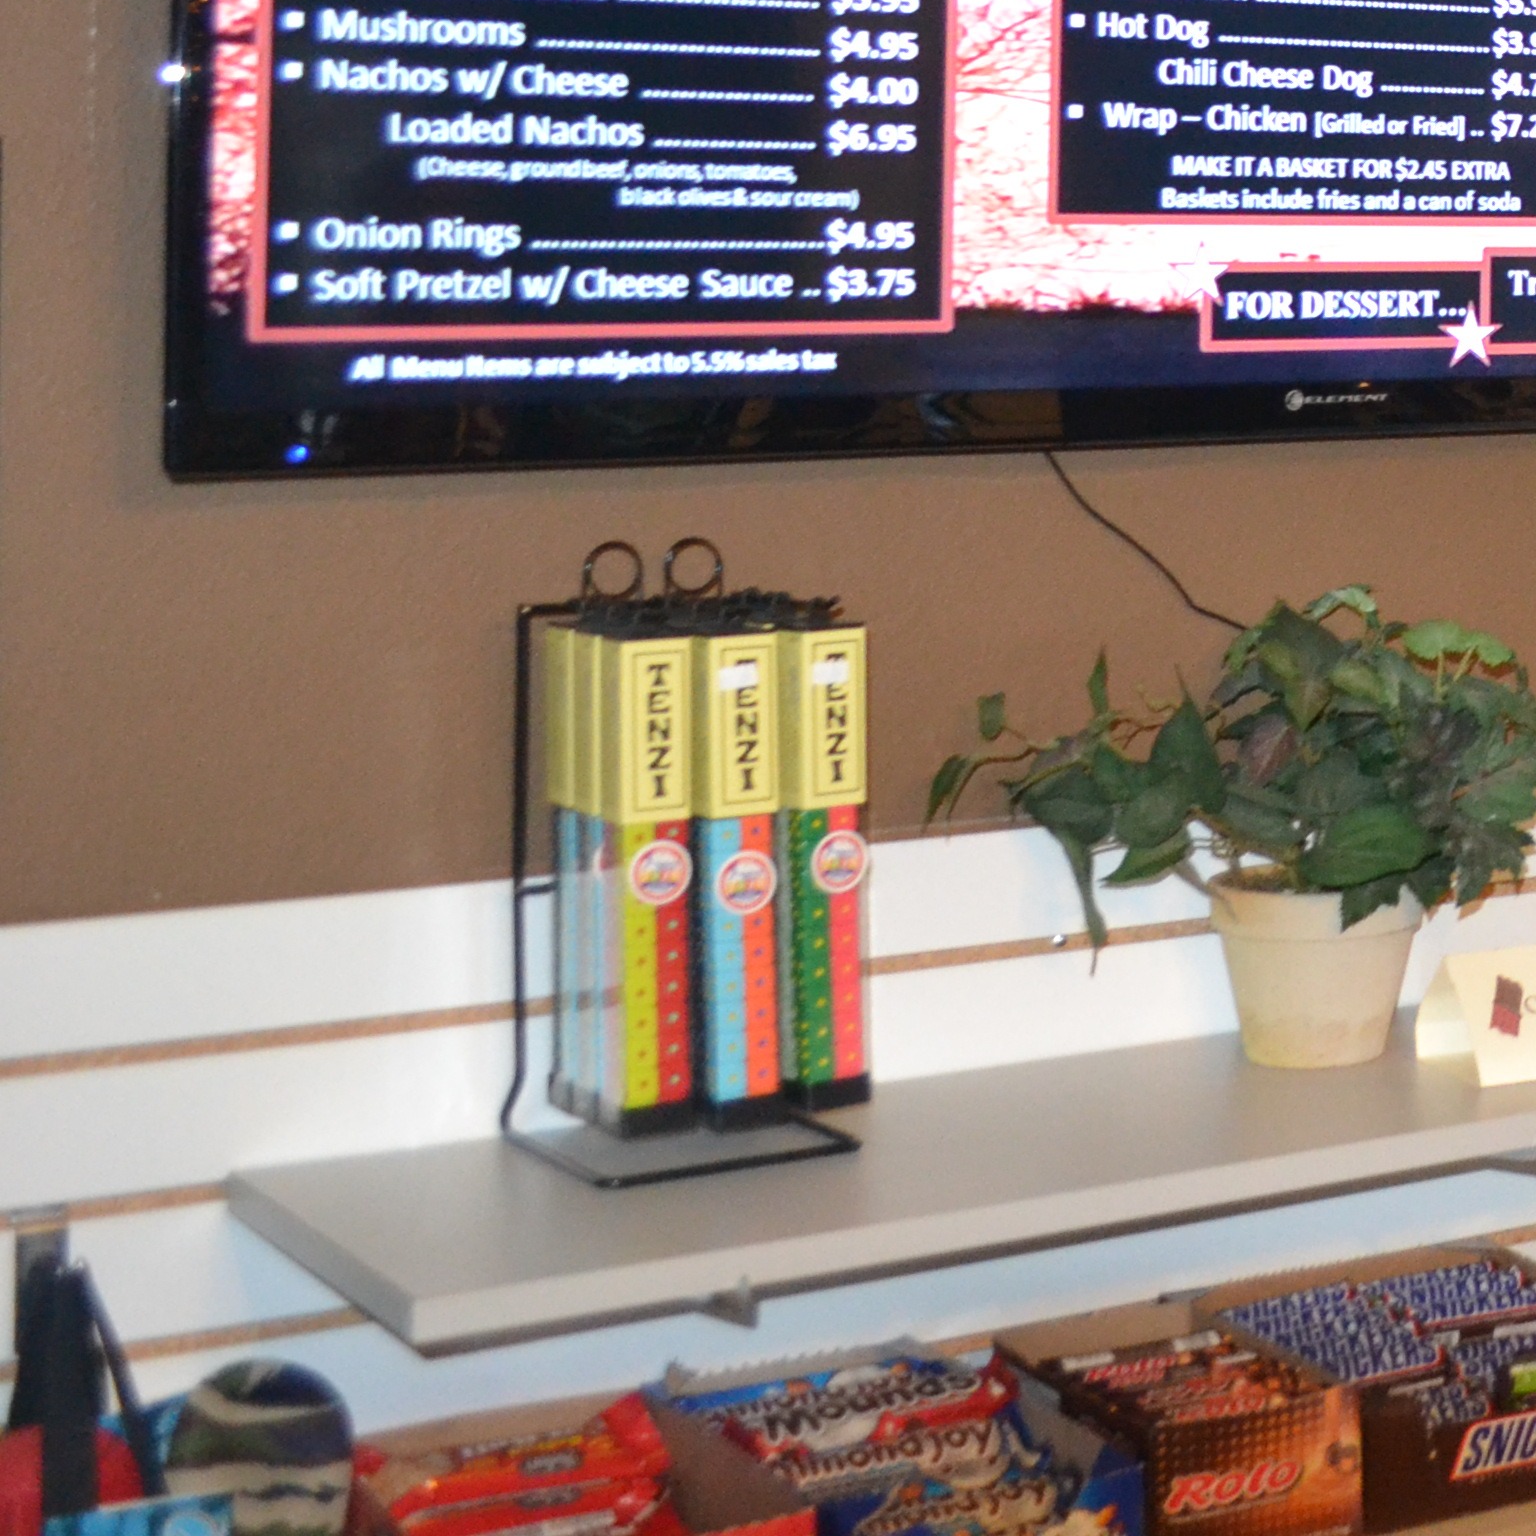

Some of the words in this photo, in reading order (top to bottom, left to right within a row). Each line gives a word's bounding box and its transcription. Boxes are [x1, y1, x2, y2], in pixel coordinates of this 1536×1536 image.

[312, 216, 422, 250] Onion
[429, 217, 521, 257] Rings
[823, 218, 915, 255] $4.95
[1226, 291, 1294, 320] FOR
[647, 663, 671, 798] TENZI
